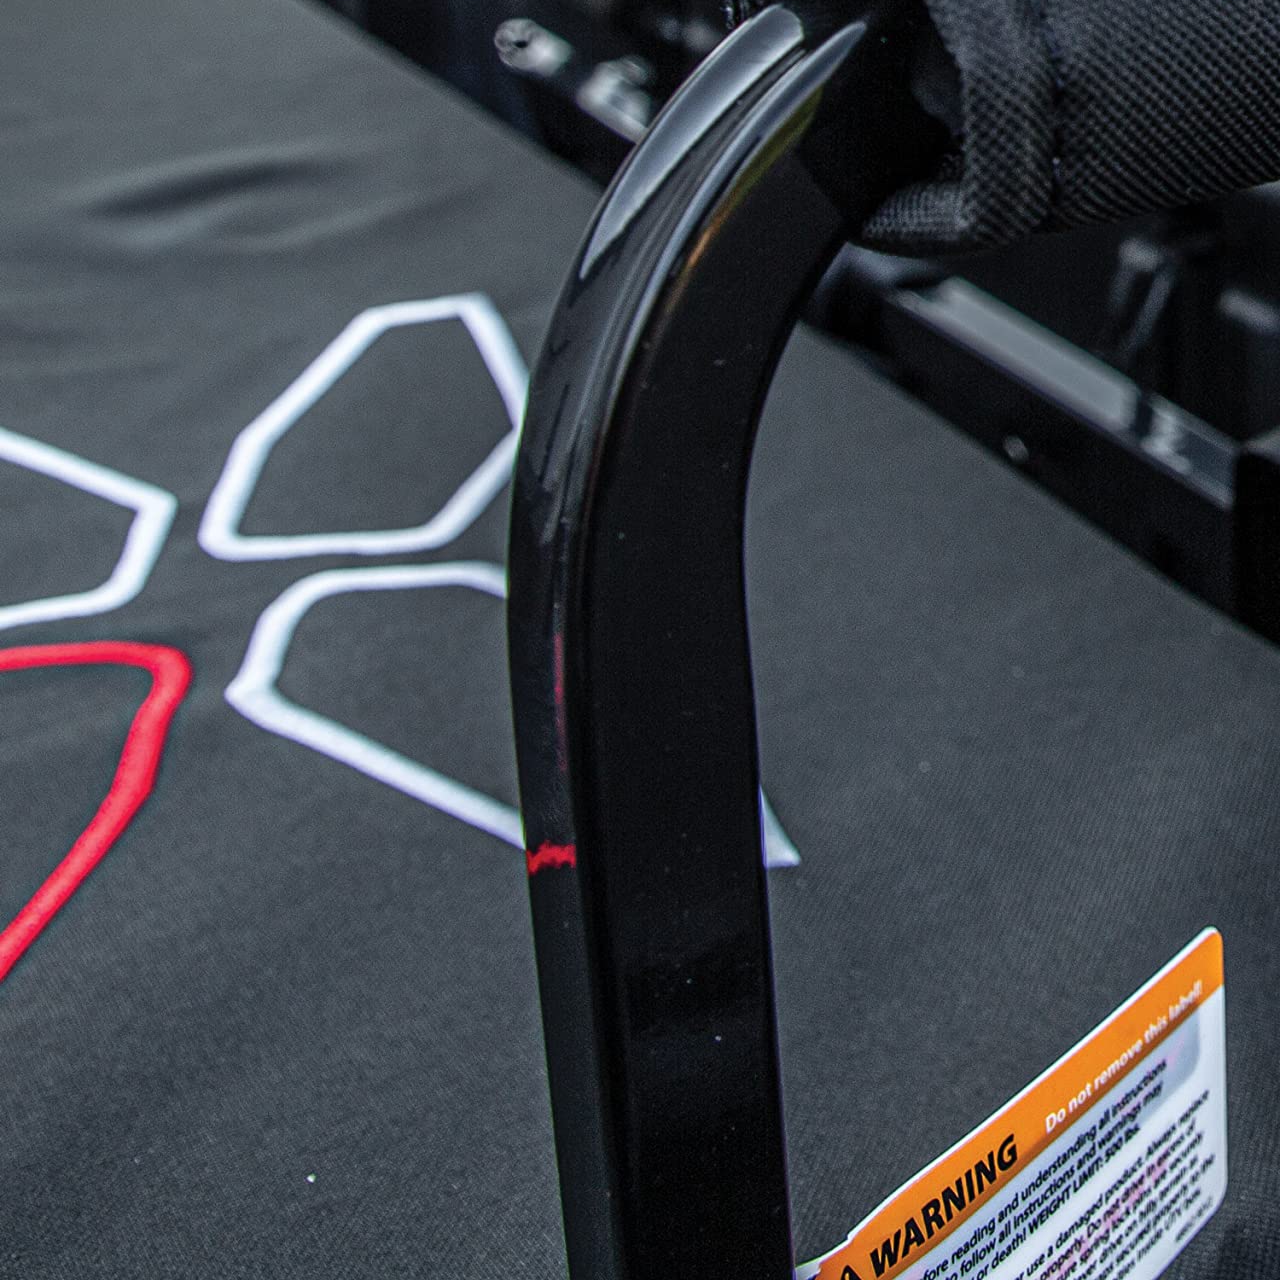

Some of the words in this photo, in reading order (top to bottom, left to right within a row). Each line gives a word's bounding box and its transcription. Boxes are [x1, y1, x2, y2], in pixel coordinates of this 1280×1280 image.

[1045, 1107, 1066, 1133] Do
[1068, 1083, 1092, 1115] not
[1094, 1039, 1143, 1090] remove
[1144, 1016, 1168, 1043] this
[870, 1133, 1017, 1278] WARNING
[920, 1259, 949, 1280] fore
[951, 1217, 996, 1264] reading
[998, 1192, 1019, 1223] and
[1021, 1124, 1097, 1201] understanding
[1099, 1108, 1110, 1130] all
[1111, 1058, 1167, 1118] instructions
[960, 1237, 997, 1277] follow
[998, 1220, 1011, 1243] all
[1013, 1165, 1075, 1230] instructions
[1077, 1142, 1096, 1170] and
[1098, 1101, 1141, 1149] warnings
[992, 1227, 1026, 1269] death!
[1028, 1184, 1071, 1234] WEIGHT
[1073, 1156, 1103, 1193] LIMIT:
[1026, 1253, 1045, 1277] use
[1056, 1193, 1103, 1249] damaged
